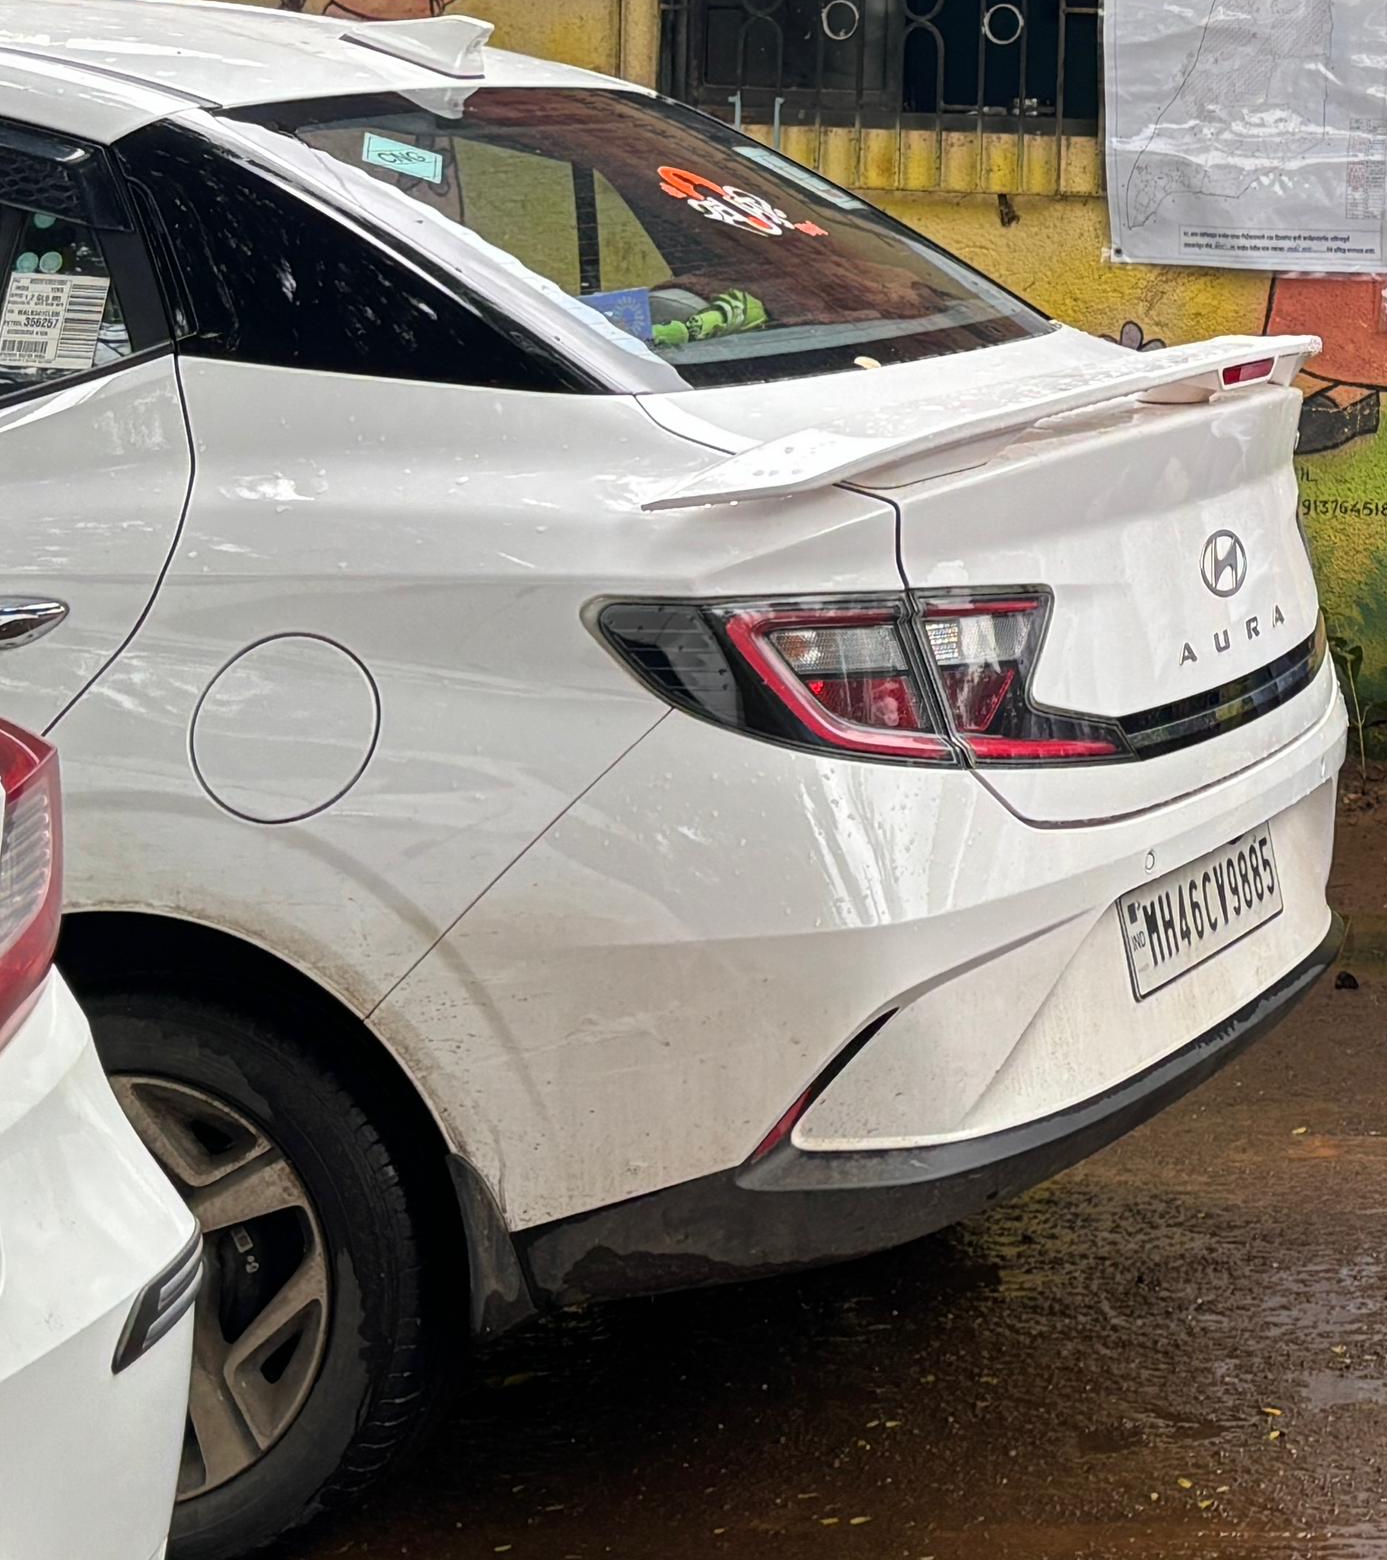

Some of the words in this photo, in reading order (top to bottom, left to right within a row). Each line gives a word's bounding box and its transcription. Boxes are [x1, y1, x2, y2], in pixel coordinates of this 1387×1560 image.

[1179, 604, 1285, 667] AURA
[1142, 836, 1275, 968] MH46CV9885
[1131, 930, 1146, 952] IND
